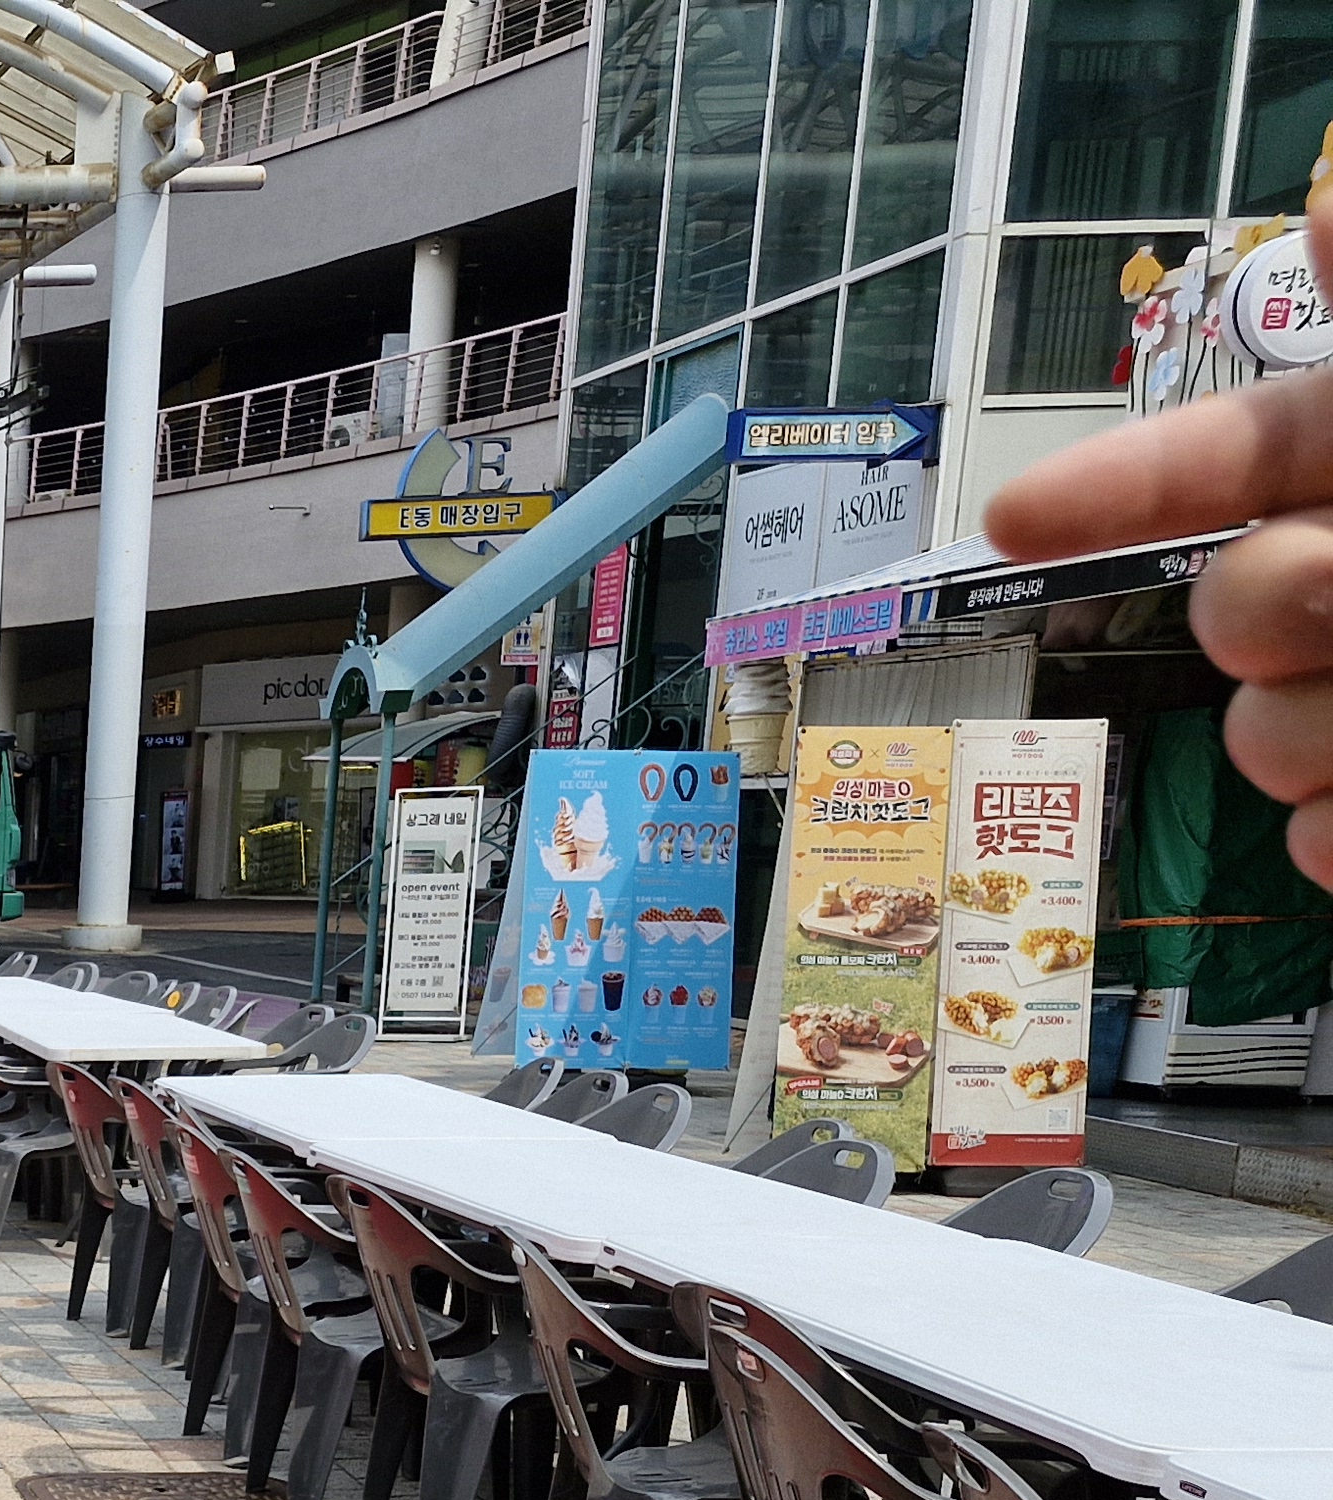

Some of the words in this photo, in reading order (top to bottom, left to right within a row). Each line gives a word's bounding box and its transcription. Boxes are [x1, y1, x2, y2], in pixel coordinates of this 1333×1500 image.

[749, 422, 850, 447] 엘리베이터
[856, 421, 897, 446] 입구
[458, 437, 513, 496] E
[860, 466, 889, 486] HAIR
[400, 507, 431, 529] E동
[440, 503, 521, 526] 매장입구
[745, 503, 805, 550] 어썸헤어
[828, 599, 894, 638] 아이스크림
[263, 679, 292, 705] pic
[559, 780, 574, 790] ICE
[575, 780, 608, 790] CREAM
[572, 770, 596, 779] SOFT
[833, 780, 864, 799] 의성
[981, 786, 1073, 818] 리턴즈
[443, 812, 467, 826] 네일
[975, 823, 1075, 861] 핫도그
[401, 884, 427, 894] open
[429, 882, 461, 892] event
